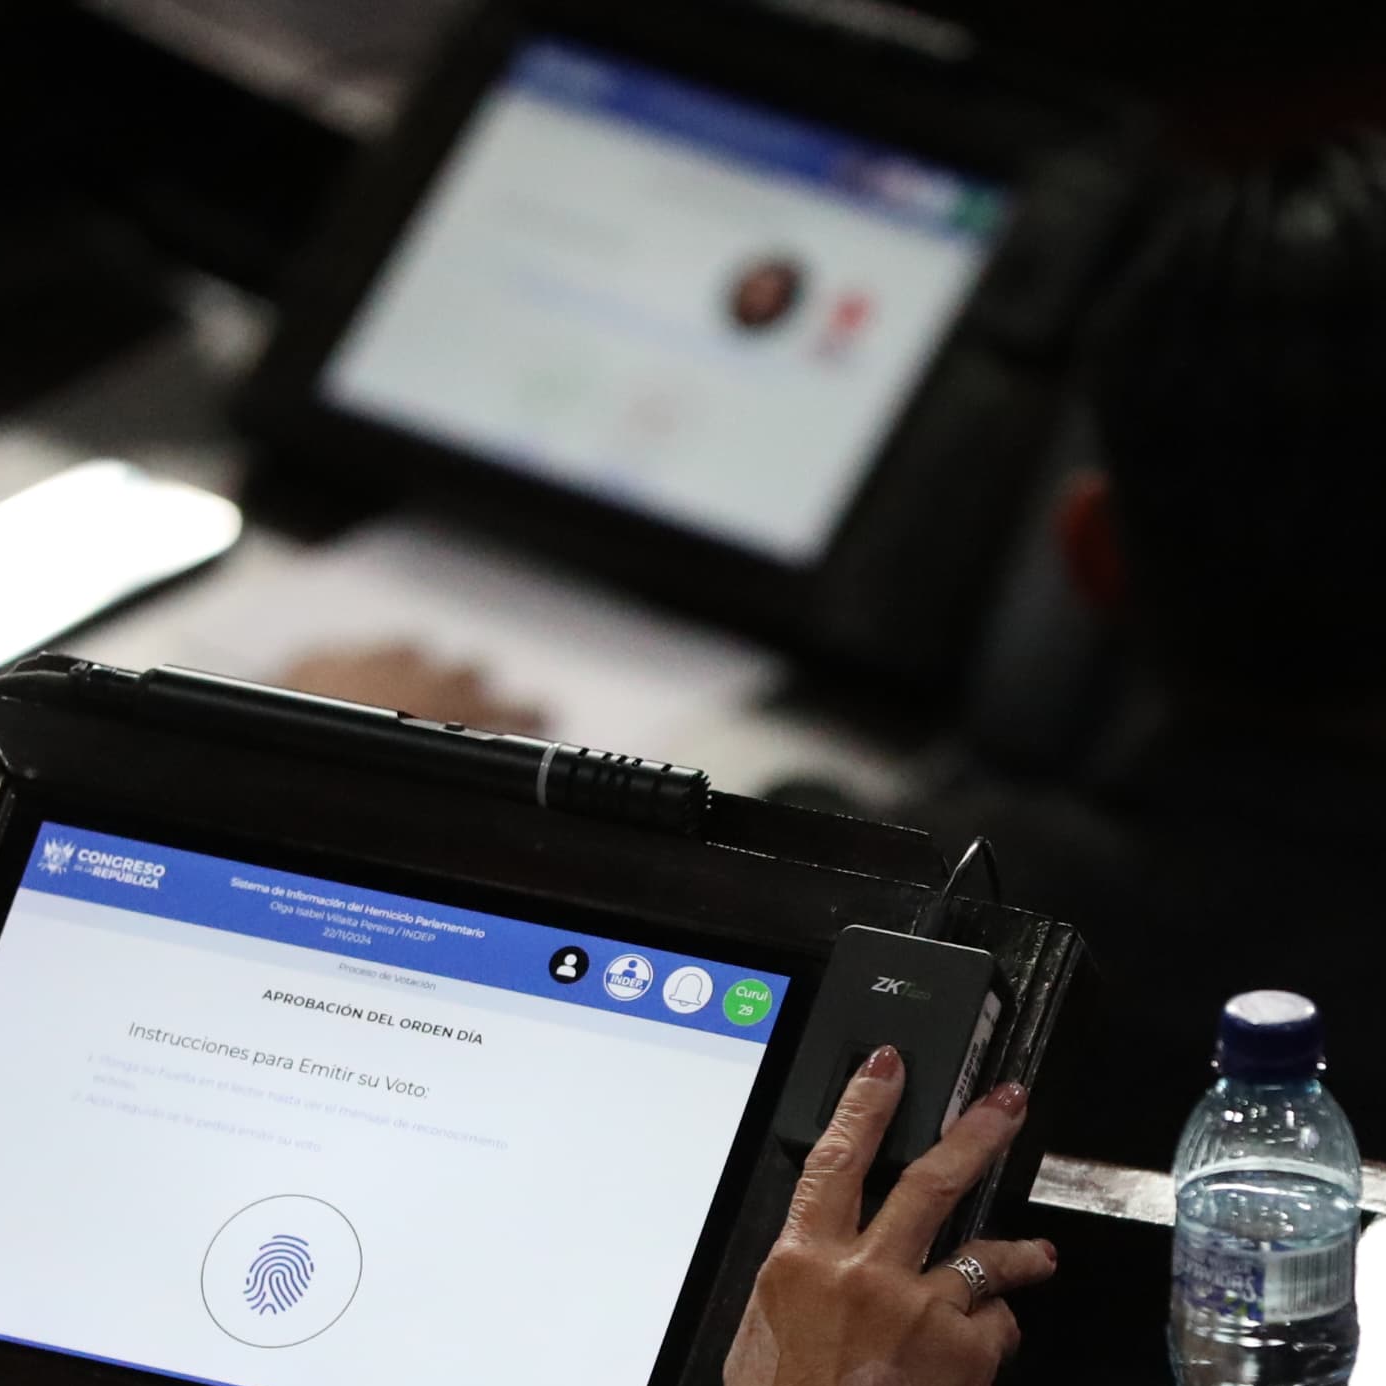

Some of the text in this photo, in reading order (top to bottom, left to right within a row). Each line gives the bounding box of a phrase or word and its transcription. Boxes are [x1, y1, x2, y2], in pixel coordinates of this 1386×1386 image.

[77, 848, 166, 877] CONGRESO
[92, 866, 159, 889] REPÚBLICA
[230, 876, 486, 938] Sistema de Información del Hemiciclo Parlamentario
[269, 901, 294, 915] Olga
[295, 906, 326, 920] Isabel
[402, 928, 437, 942] INDEP
[322, 926, 372, 945] 22/11/2024
[338, 962, 437, 991] Proceso de Votación
[735, 986, 769, 1001] Curul
[262, 989, 484, 1045] APROBACIÓN DEL ORDEN DÍA
[128, 1021, 431, 1099] Instrucciones para Emitir su Voto:
